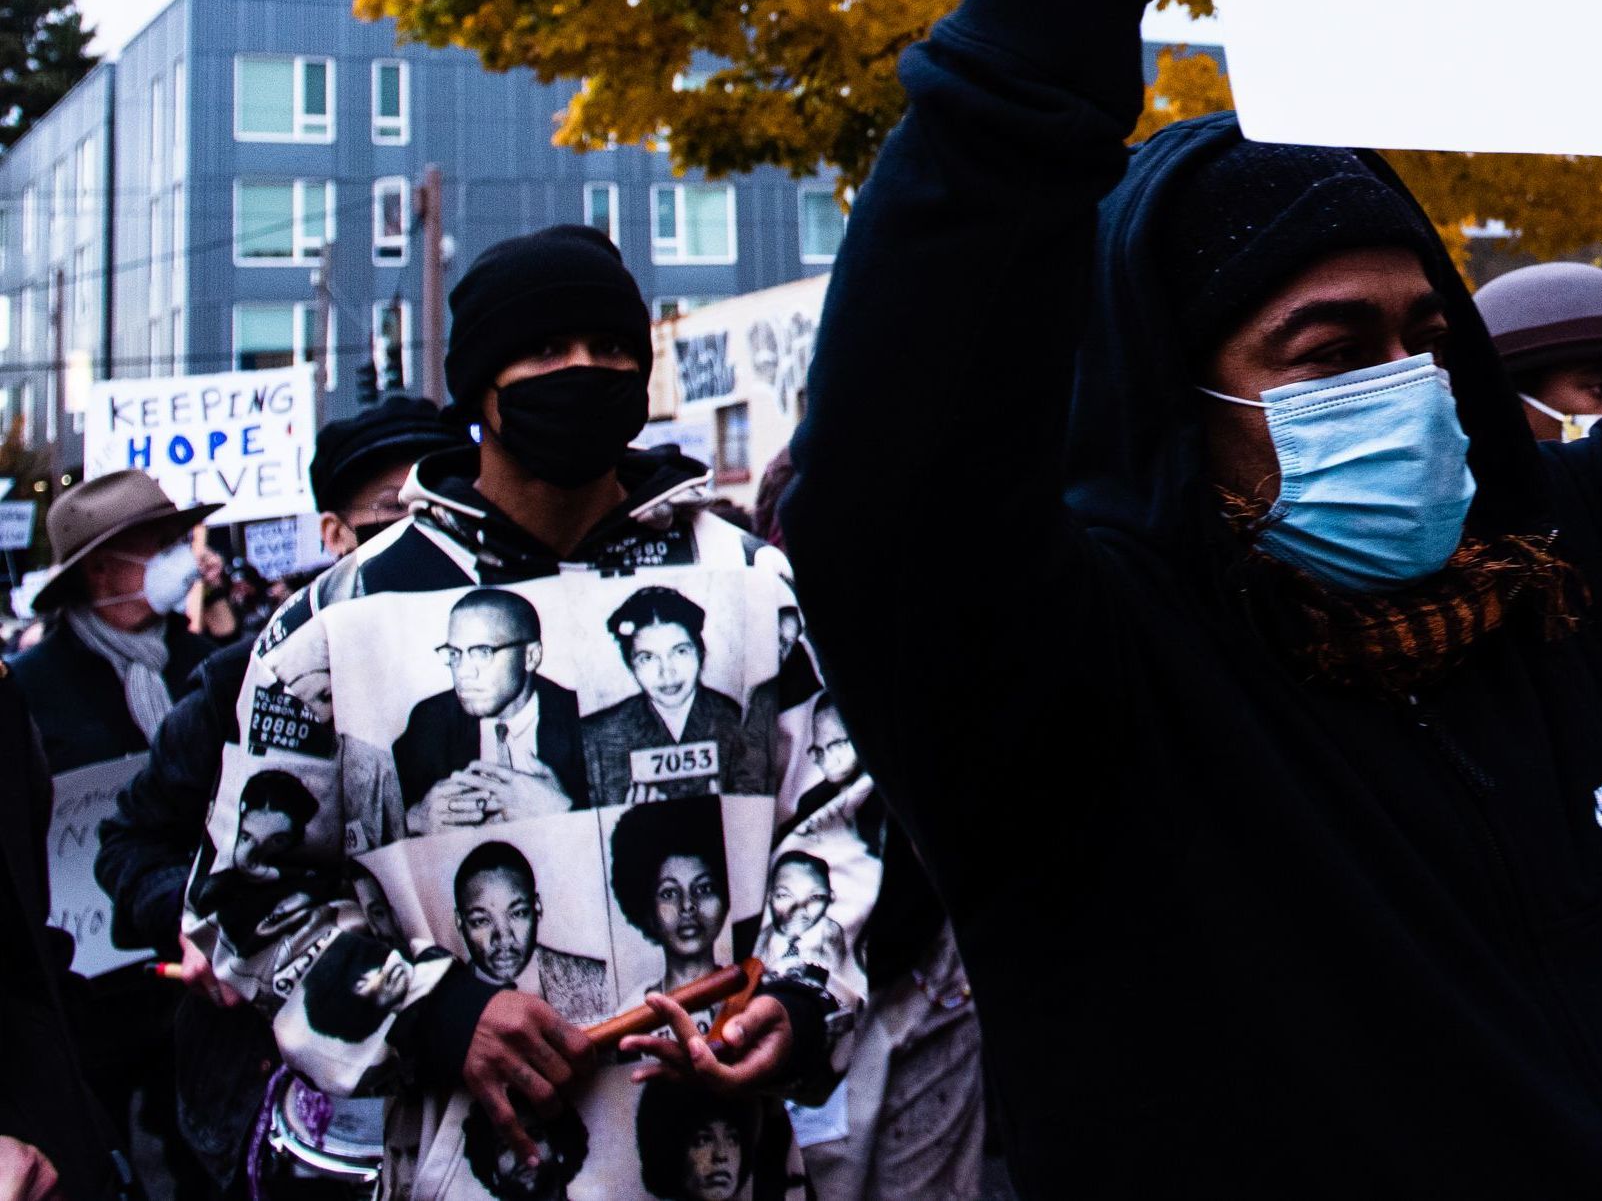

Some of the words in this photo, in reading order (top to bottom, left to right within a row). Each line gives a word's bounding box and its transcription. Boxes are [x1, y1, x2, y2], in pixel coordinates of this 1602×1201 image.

[110, 382, 294, 433] KEEPING
[127, 424, 266, 469] HOPE
[186, 445, 304, 503] IVE!
[650, 748, 713, 775] 7053
